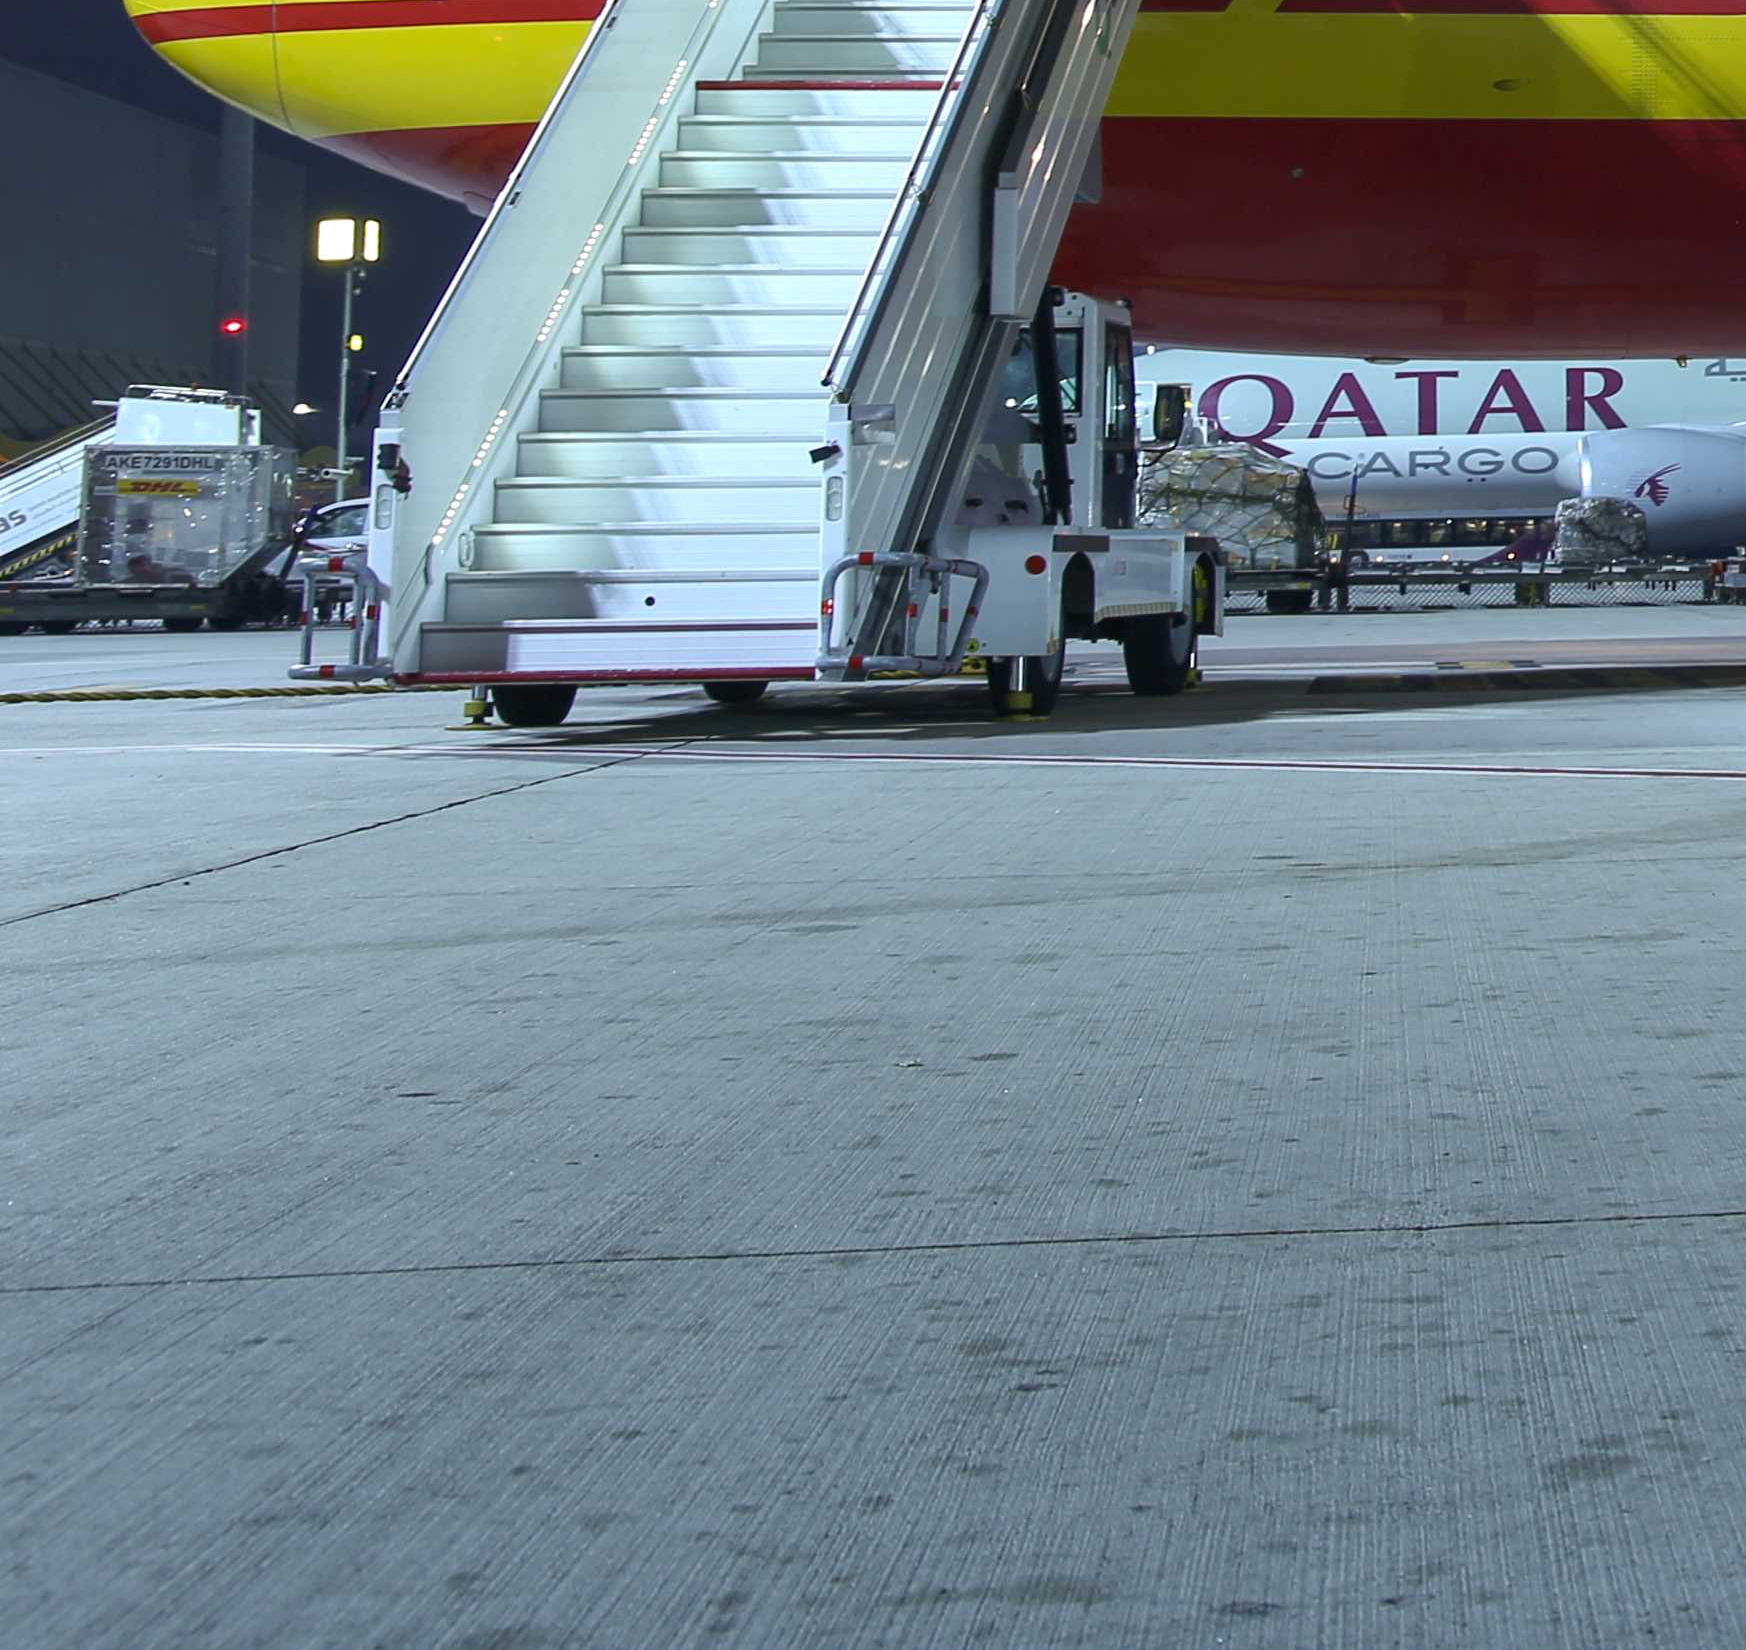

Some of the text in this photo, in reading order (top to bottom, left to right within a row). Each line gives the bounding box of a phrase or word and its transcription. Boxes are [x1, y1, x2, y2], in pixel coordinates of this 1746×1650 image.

[1199, 367, 1627, 458] QATAR
[1307, 446, 1560, 480] CARGO
[130, 481, 190, 493] DHL
